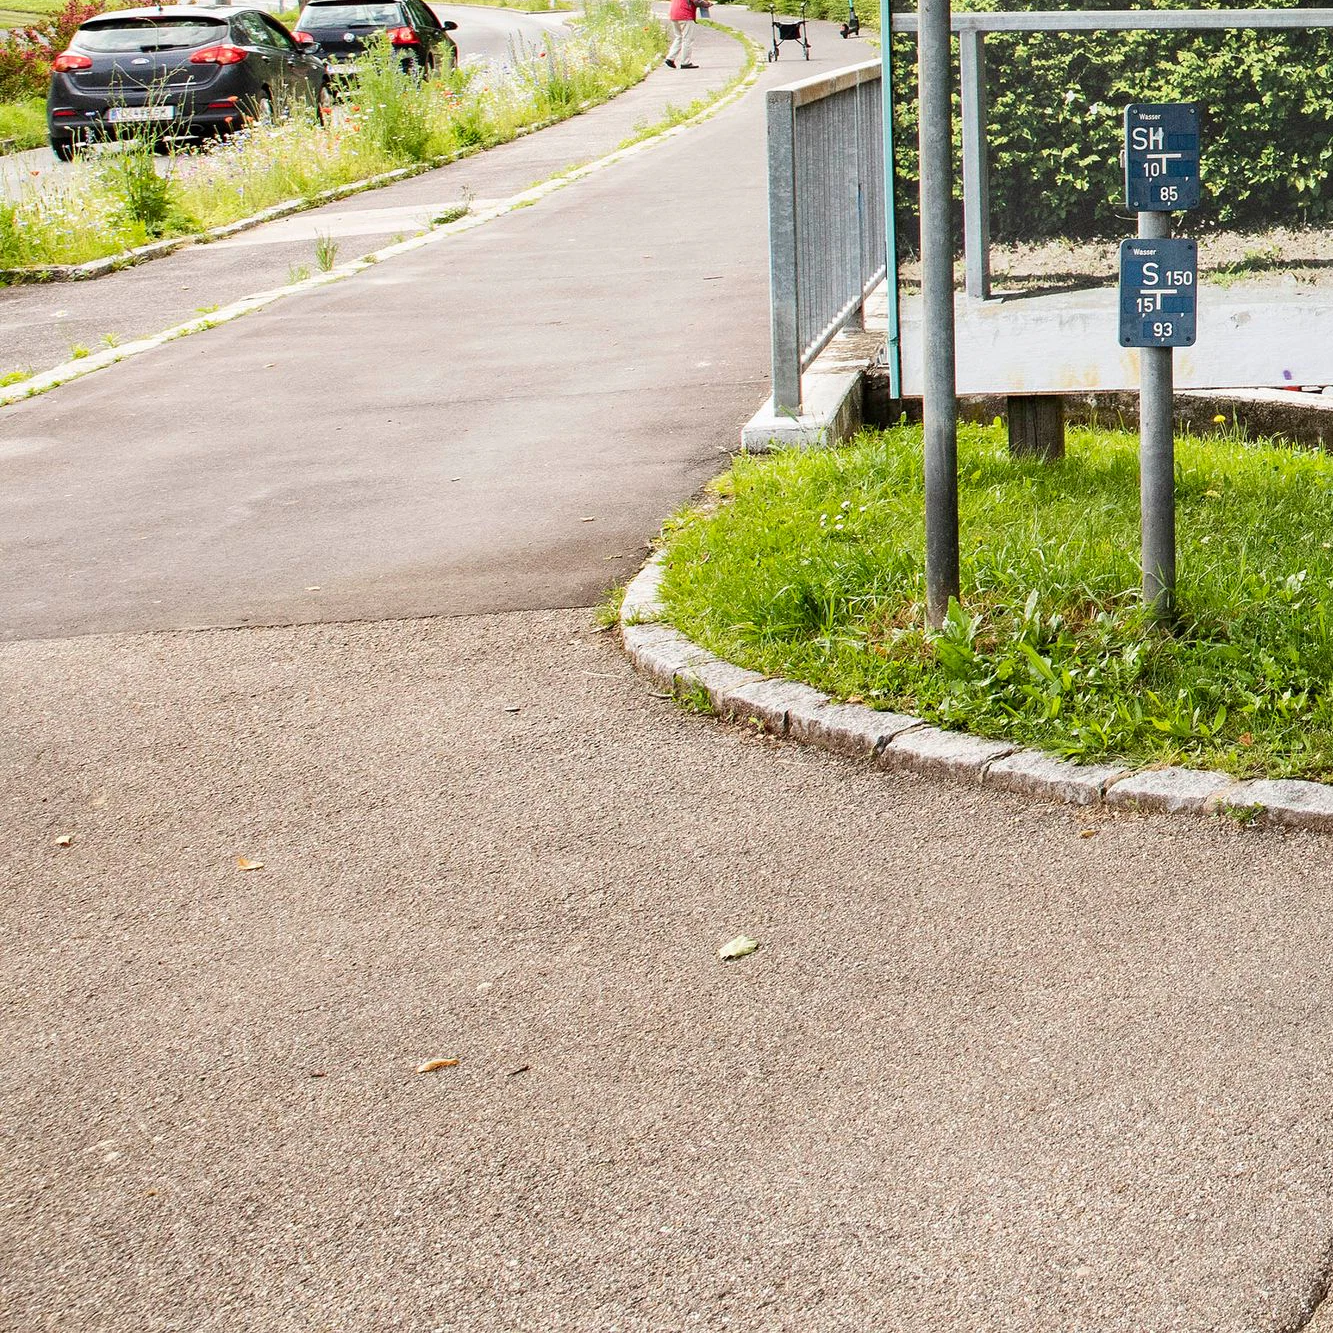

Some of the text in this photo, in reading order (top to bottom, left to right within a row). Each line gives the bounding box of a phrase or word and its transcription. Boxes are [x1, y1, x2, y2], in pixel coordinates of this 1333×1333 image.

[1138, 113, 1162, 121] Wasser
[1132, 126, 1164, 151] SH
[1133, 248, 1157, 256] Wasser
[1142, 262, 1193, 286] S 150
